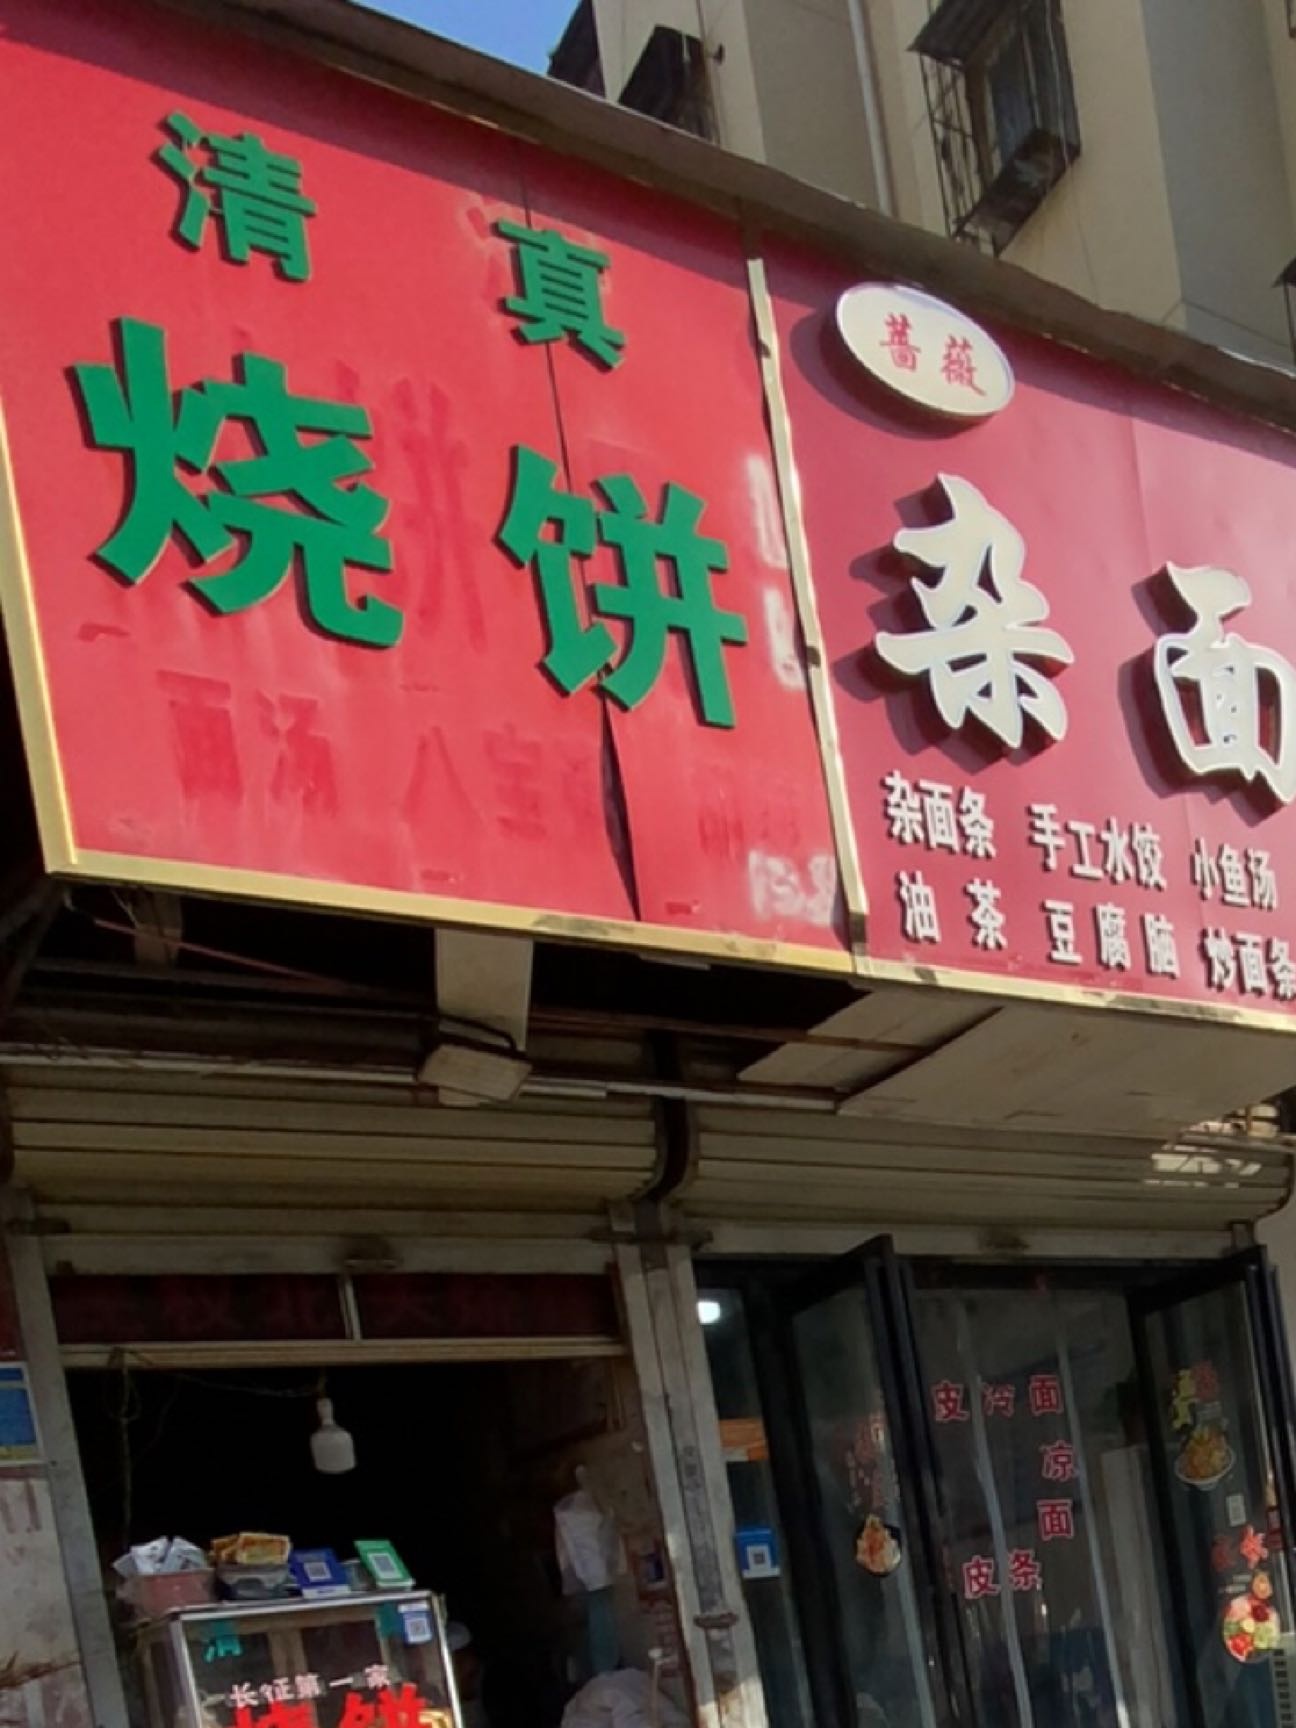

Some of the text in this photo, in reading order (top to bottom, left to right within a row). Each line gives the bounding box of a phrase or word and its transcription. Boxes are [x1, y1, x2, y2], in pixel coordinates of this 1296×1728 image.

[153, 110, 625, 370] 清真
[68, 314, 748, 730] 烧饼
[884, 768, 998, 860] 杂面条
[1028, 800, 1168, 892] 手工水饺
[1190, 835, 1280, 913] 小鱼汤
[897, 868, 1008, 952] 油茶
[1042, 896, 1182, 980] 豆腐脑
